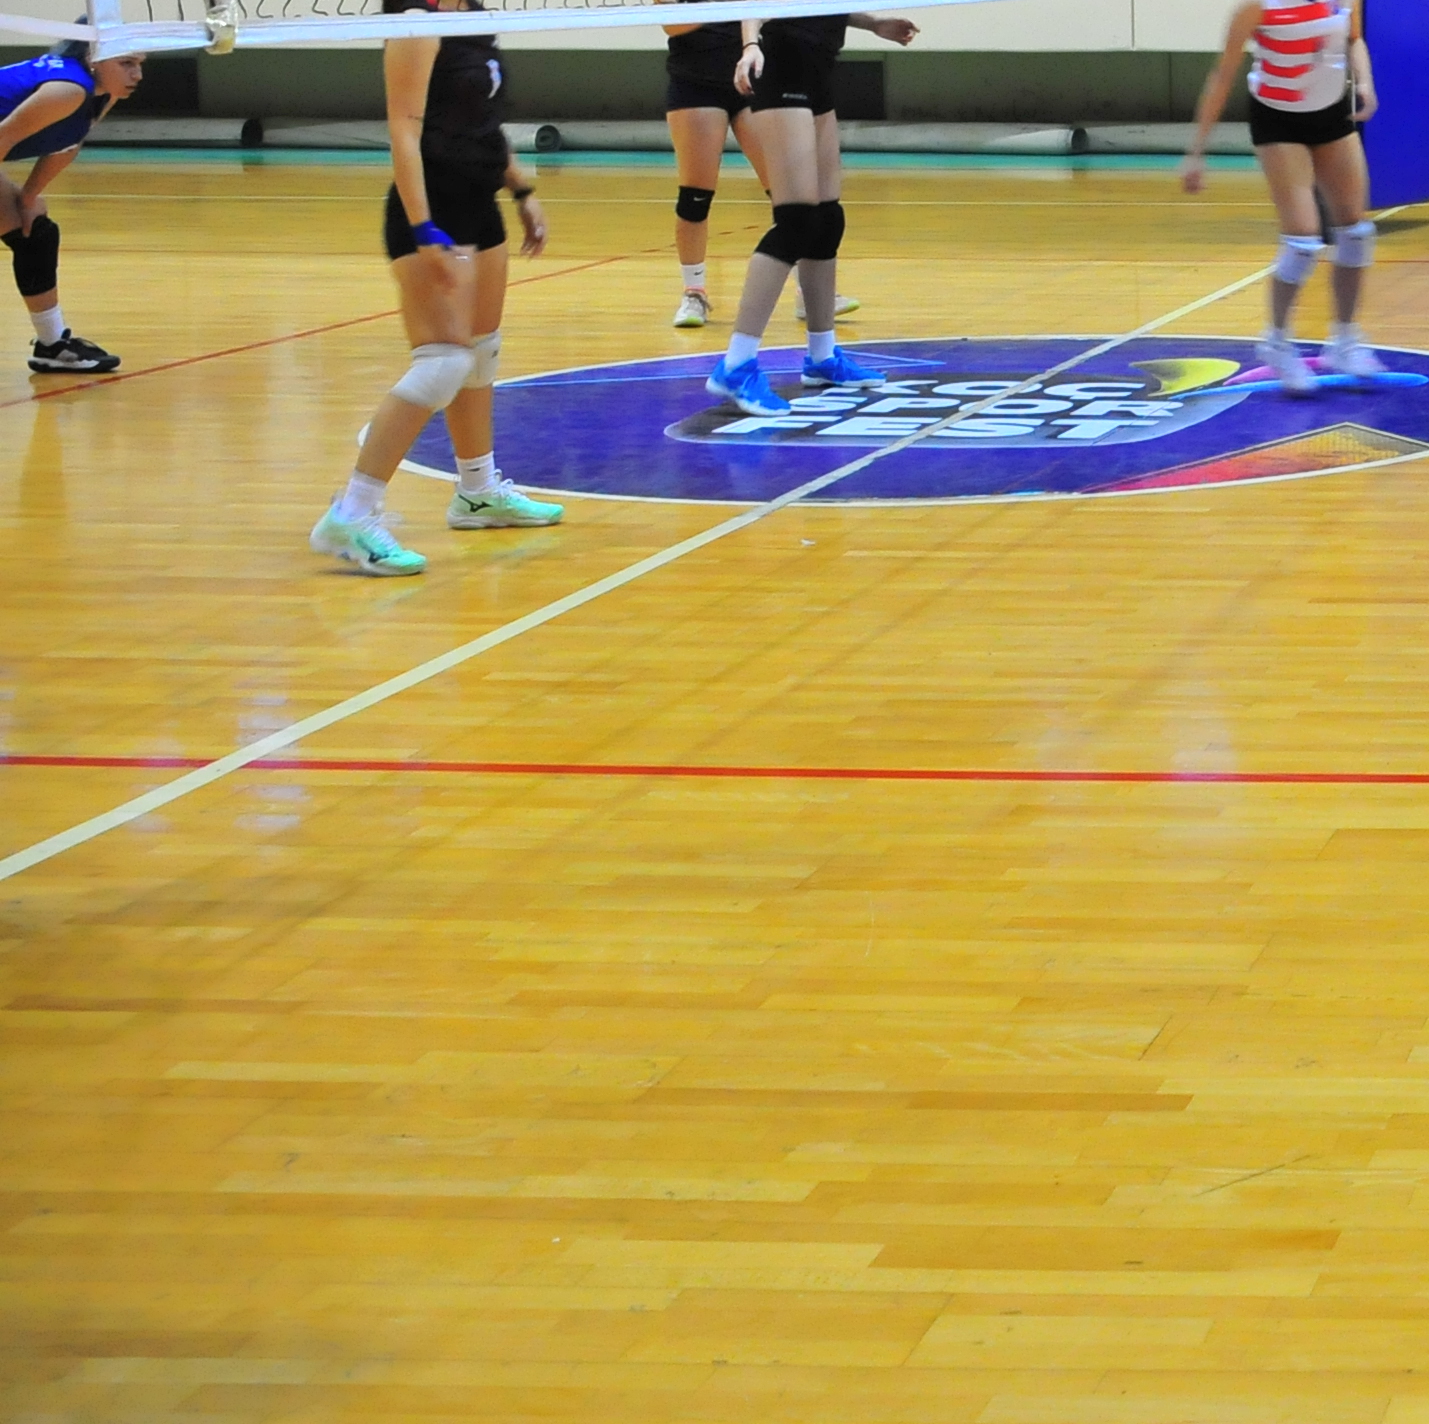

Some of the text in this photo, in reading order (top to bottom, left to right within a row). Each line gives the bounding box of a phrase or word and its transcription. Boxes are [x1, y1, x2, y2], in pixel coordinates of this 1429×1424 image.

[821, 379, 1146, 400] KOÇ
[789, 396, 1182, 417] SPOR
[711, 416, 1160, 439] FEST
